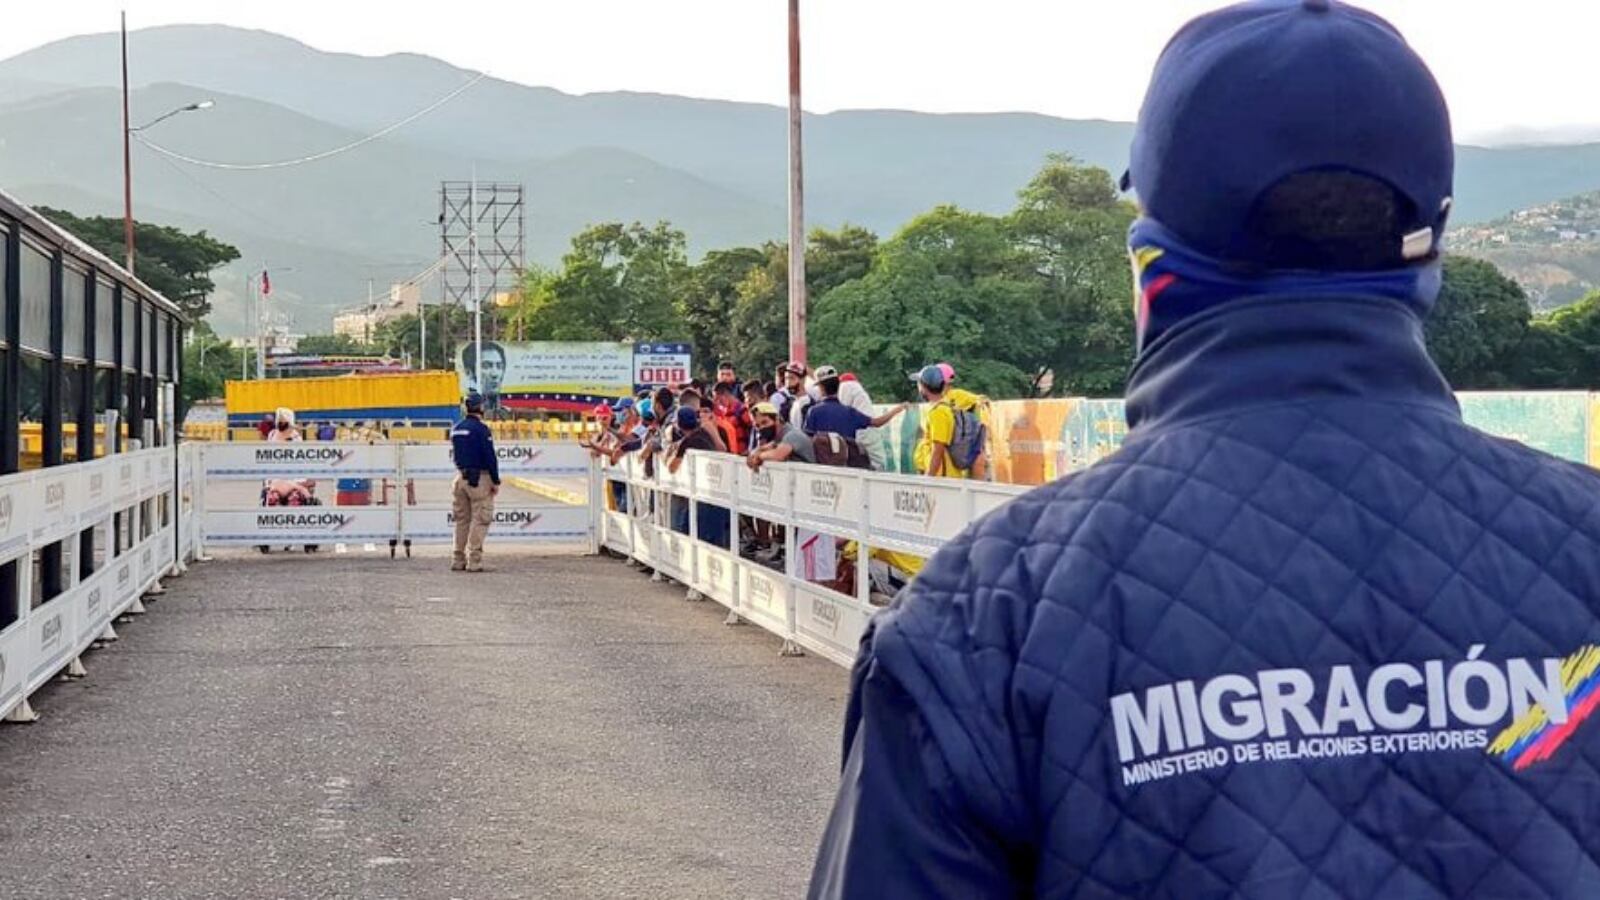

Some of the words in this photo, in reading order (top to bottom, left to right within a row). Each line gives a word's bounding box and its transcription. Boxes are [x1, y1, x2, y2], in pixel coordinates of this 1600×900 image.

[256, 447, 343, 460] MIGRACIÓN
[257, 512, 344, 525] MIGRACIÓN
[1110, 644, 1568, 762] MIGRACIÓN
[1123, 747, 1229, 785] MINISTERIO
[1233, 743, 1261, 763] DE
[1263, 736, 1367, 760] RELACIONES
[1371, 728, 1489, 753] EXTERIORES
